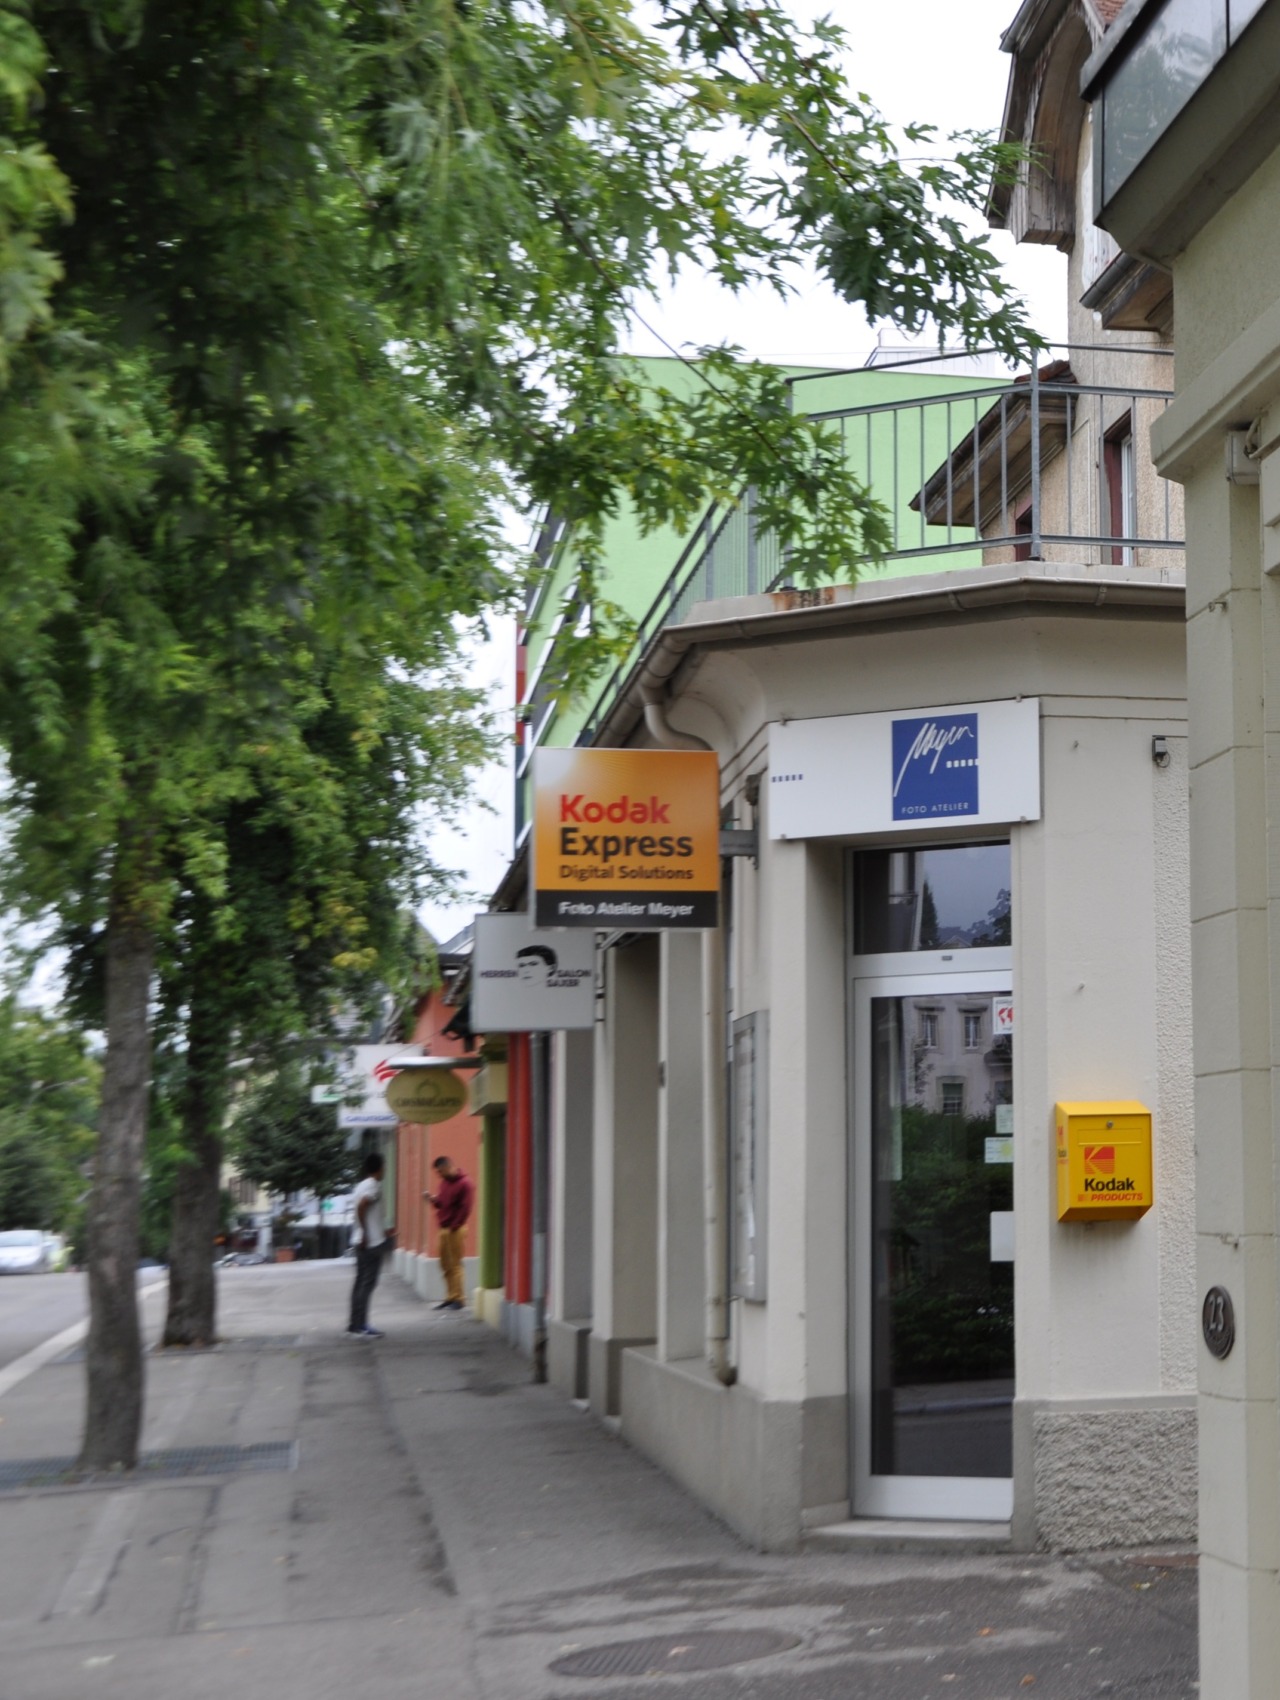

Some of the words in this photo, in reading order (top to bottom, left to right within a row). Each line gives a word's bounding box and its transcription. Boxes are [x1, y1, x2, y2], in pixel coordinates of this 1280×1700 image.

[559, 794, 671, 824] Kodak
[902, 806, 927, 814] FOTO
[932, 802, 969, 811] ATELIER
[560, 827, 694, 863] Express
[559, 865, 615, 882] Digital
[618, 865, 695, 880] Solutions
[558, 902, 595, 916] Foto
[596, 902, 645, 916] Atelier
[647, 902, 695, 918] Meyer
[479, 969, 519, 978] HERREN
[556, 969, 592, 978] SALON
[1084, 1177, 1136, 1192] Kodak
[1090, 1192, 1144, 1202] PRODUCTS
